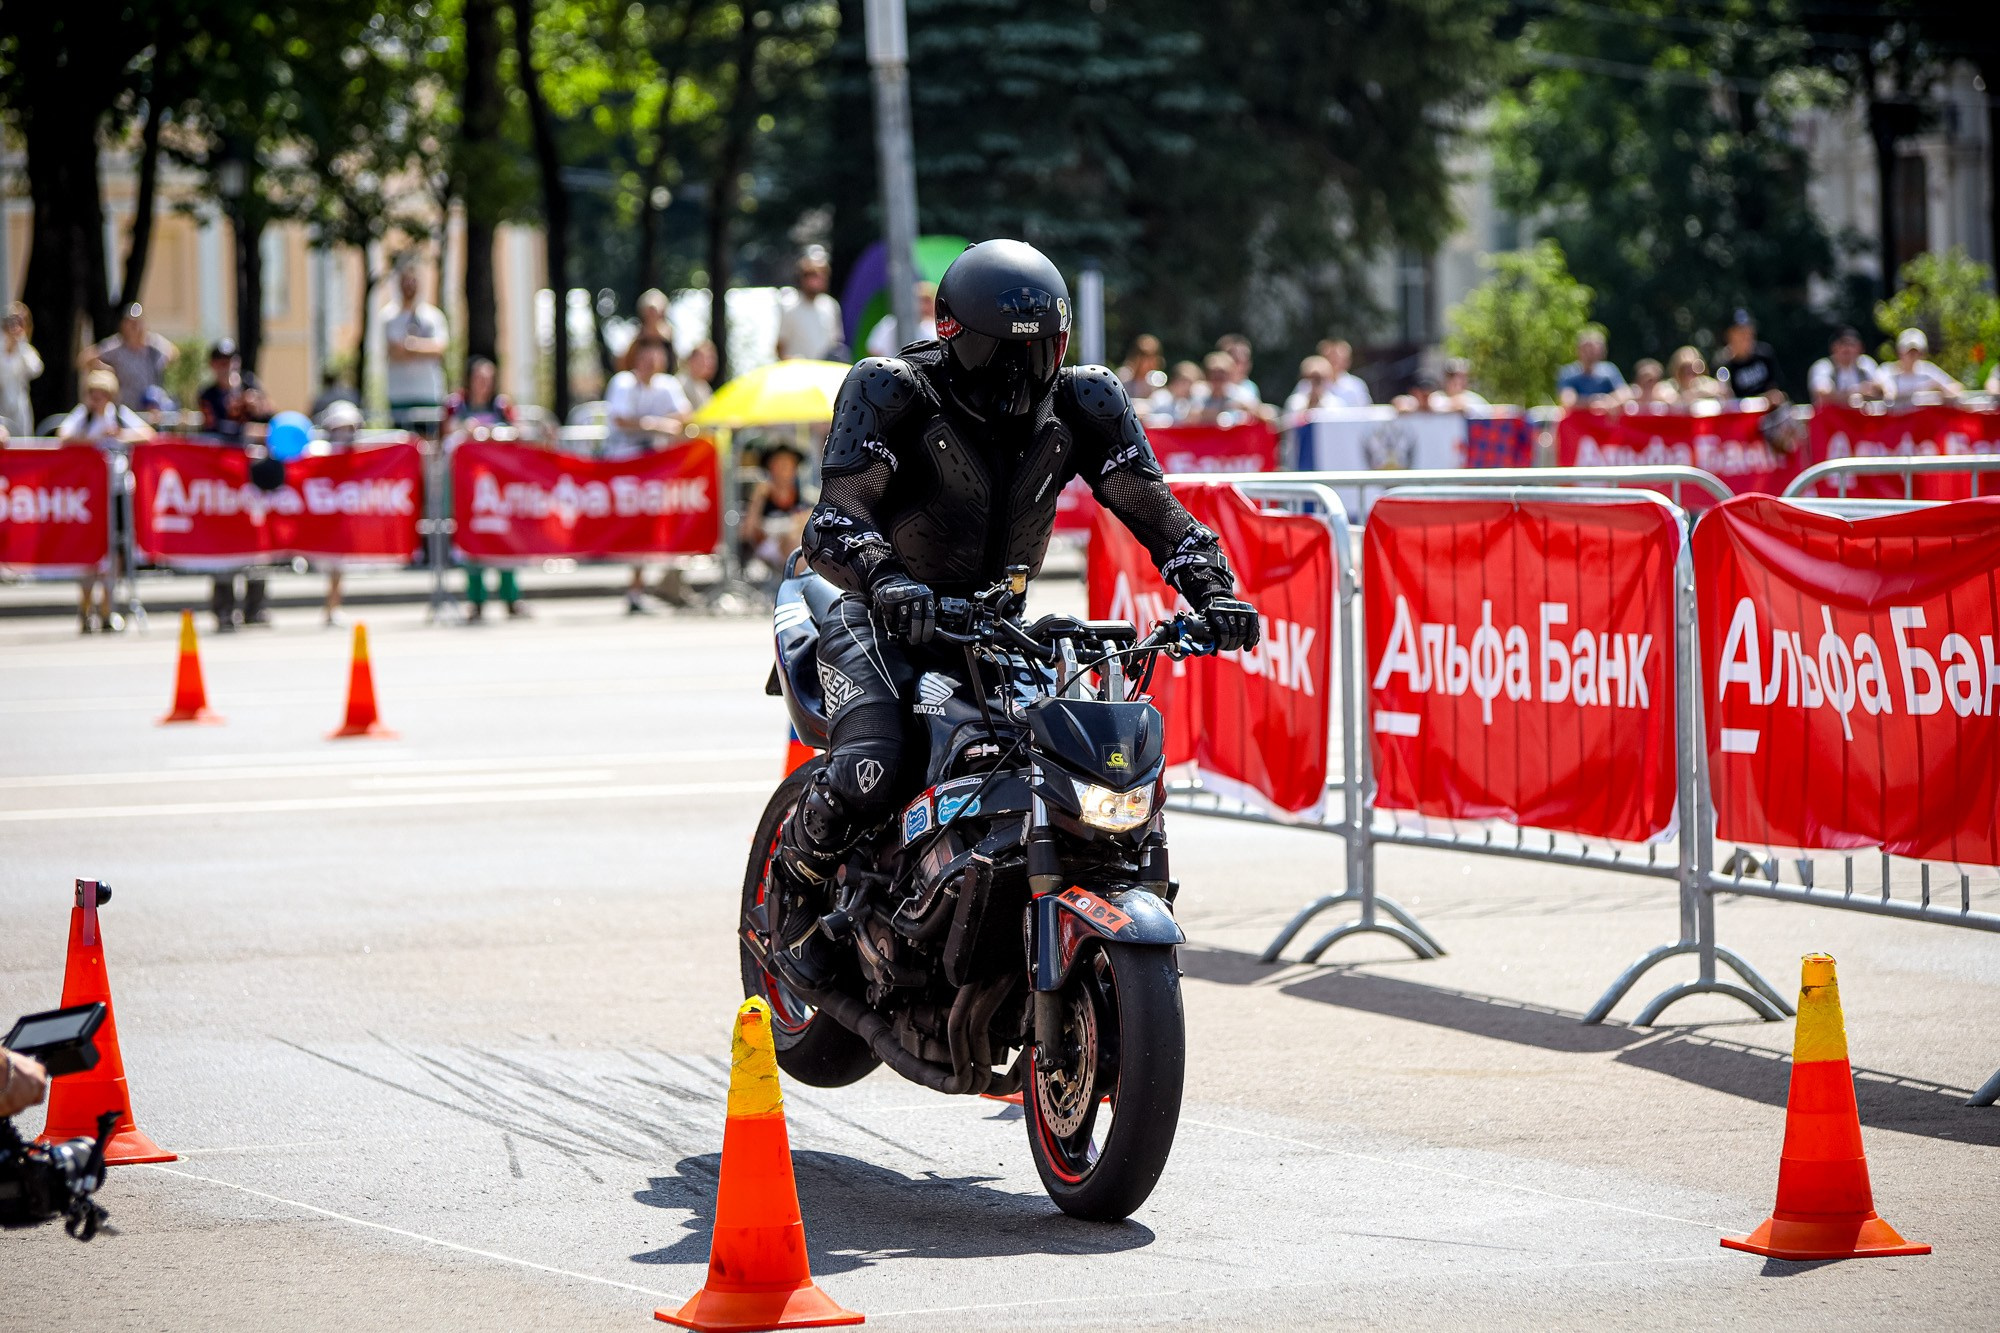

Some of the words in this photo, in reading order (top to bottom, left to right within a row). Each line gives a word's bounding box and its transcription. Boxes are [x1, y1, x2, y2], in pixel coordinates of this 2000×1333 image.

[153, 468, 304, 526] Альфа
[303, 477, 414, 516] Банк
[472, 473, 611, 529] Альфа
[611, 475, 711, 517] Банк
[1216, 614, 1316, 697] анк
[1372, 594, 1532, 725] Альфа
[1539, 602, 1653, 709] Банк
[1719, 597, 1893, 741] Альфа
[913, 704, 946, 716] HONDA
